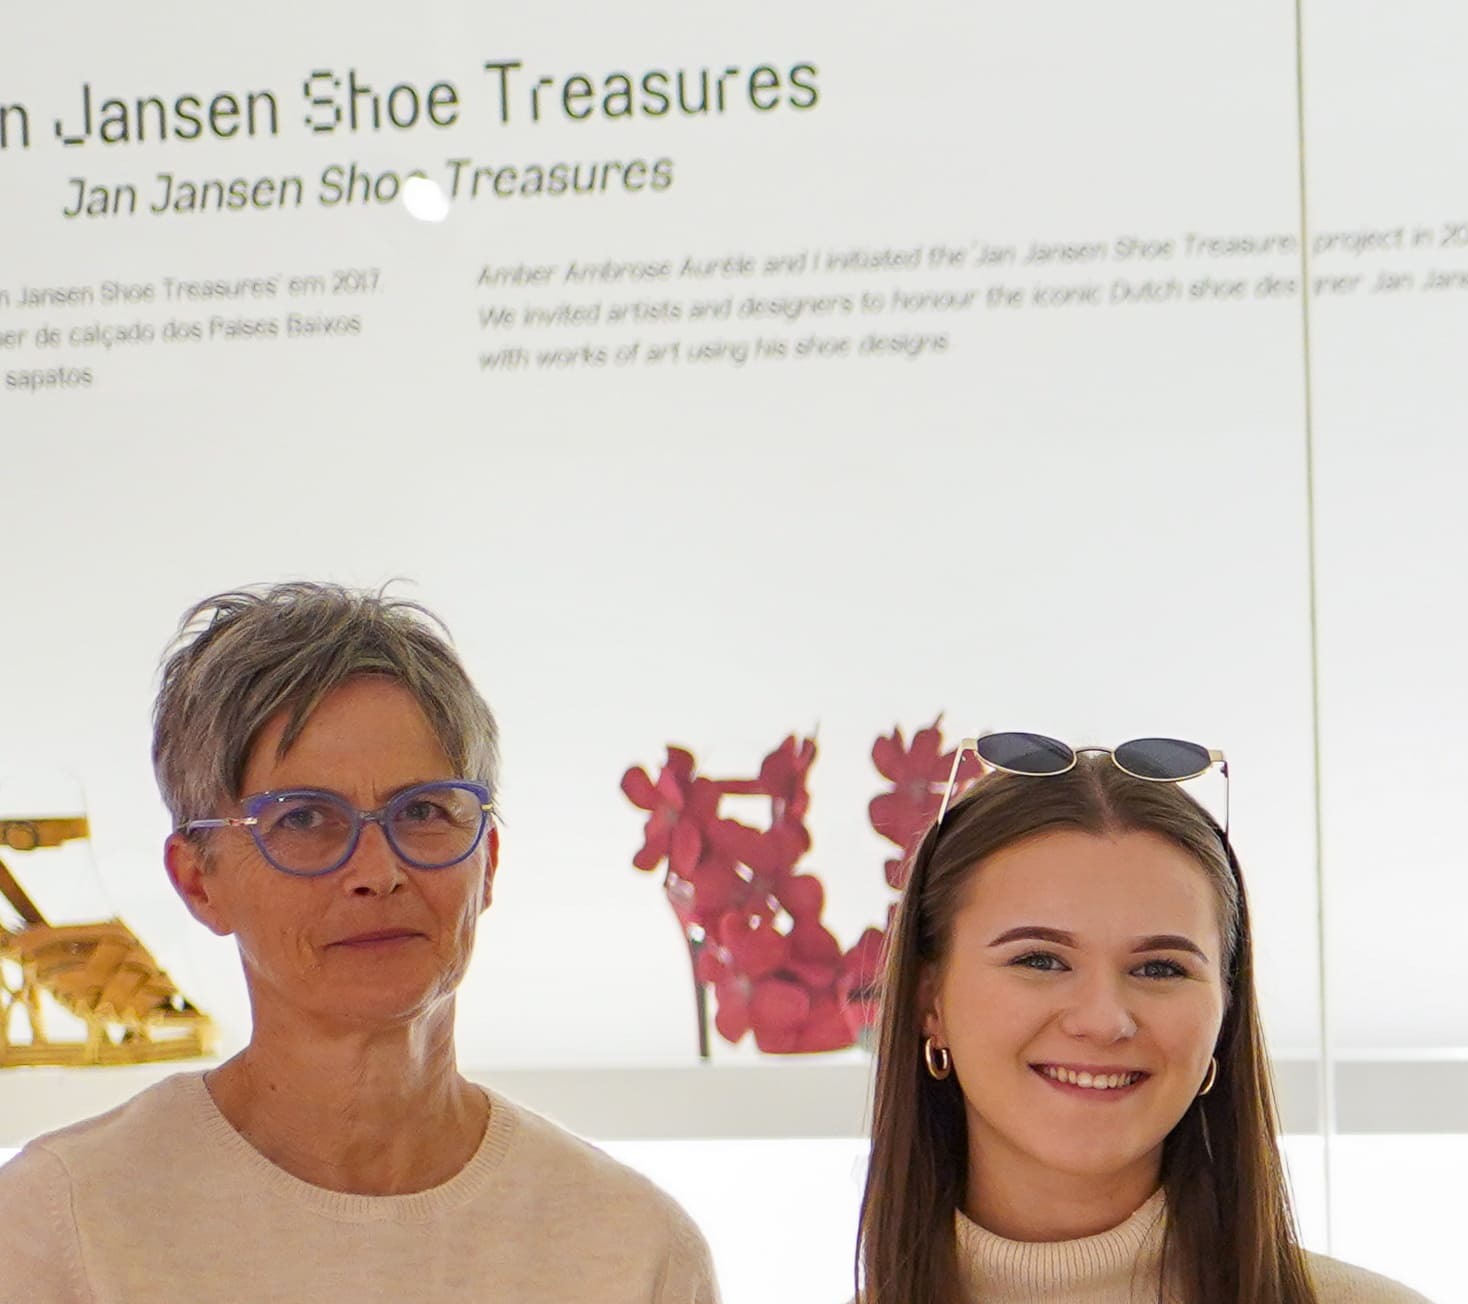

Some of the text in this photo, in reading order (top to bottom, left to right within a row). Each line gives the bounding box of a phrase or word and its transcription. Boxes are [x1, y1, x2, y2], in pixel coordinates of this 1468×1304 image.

[54, 83, 278, 145] Jansen
[303, 69, 458, 133] Shoe
[484, 60, 818, 123] Treasures
[63, 158, 672, 218] Jan Jansen Sho Treasures
